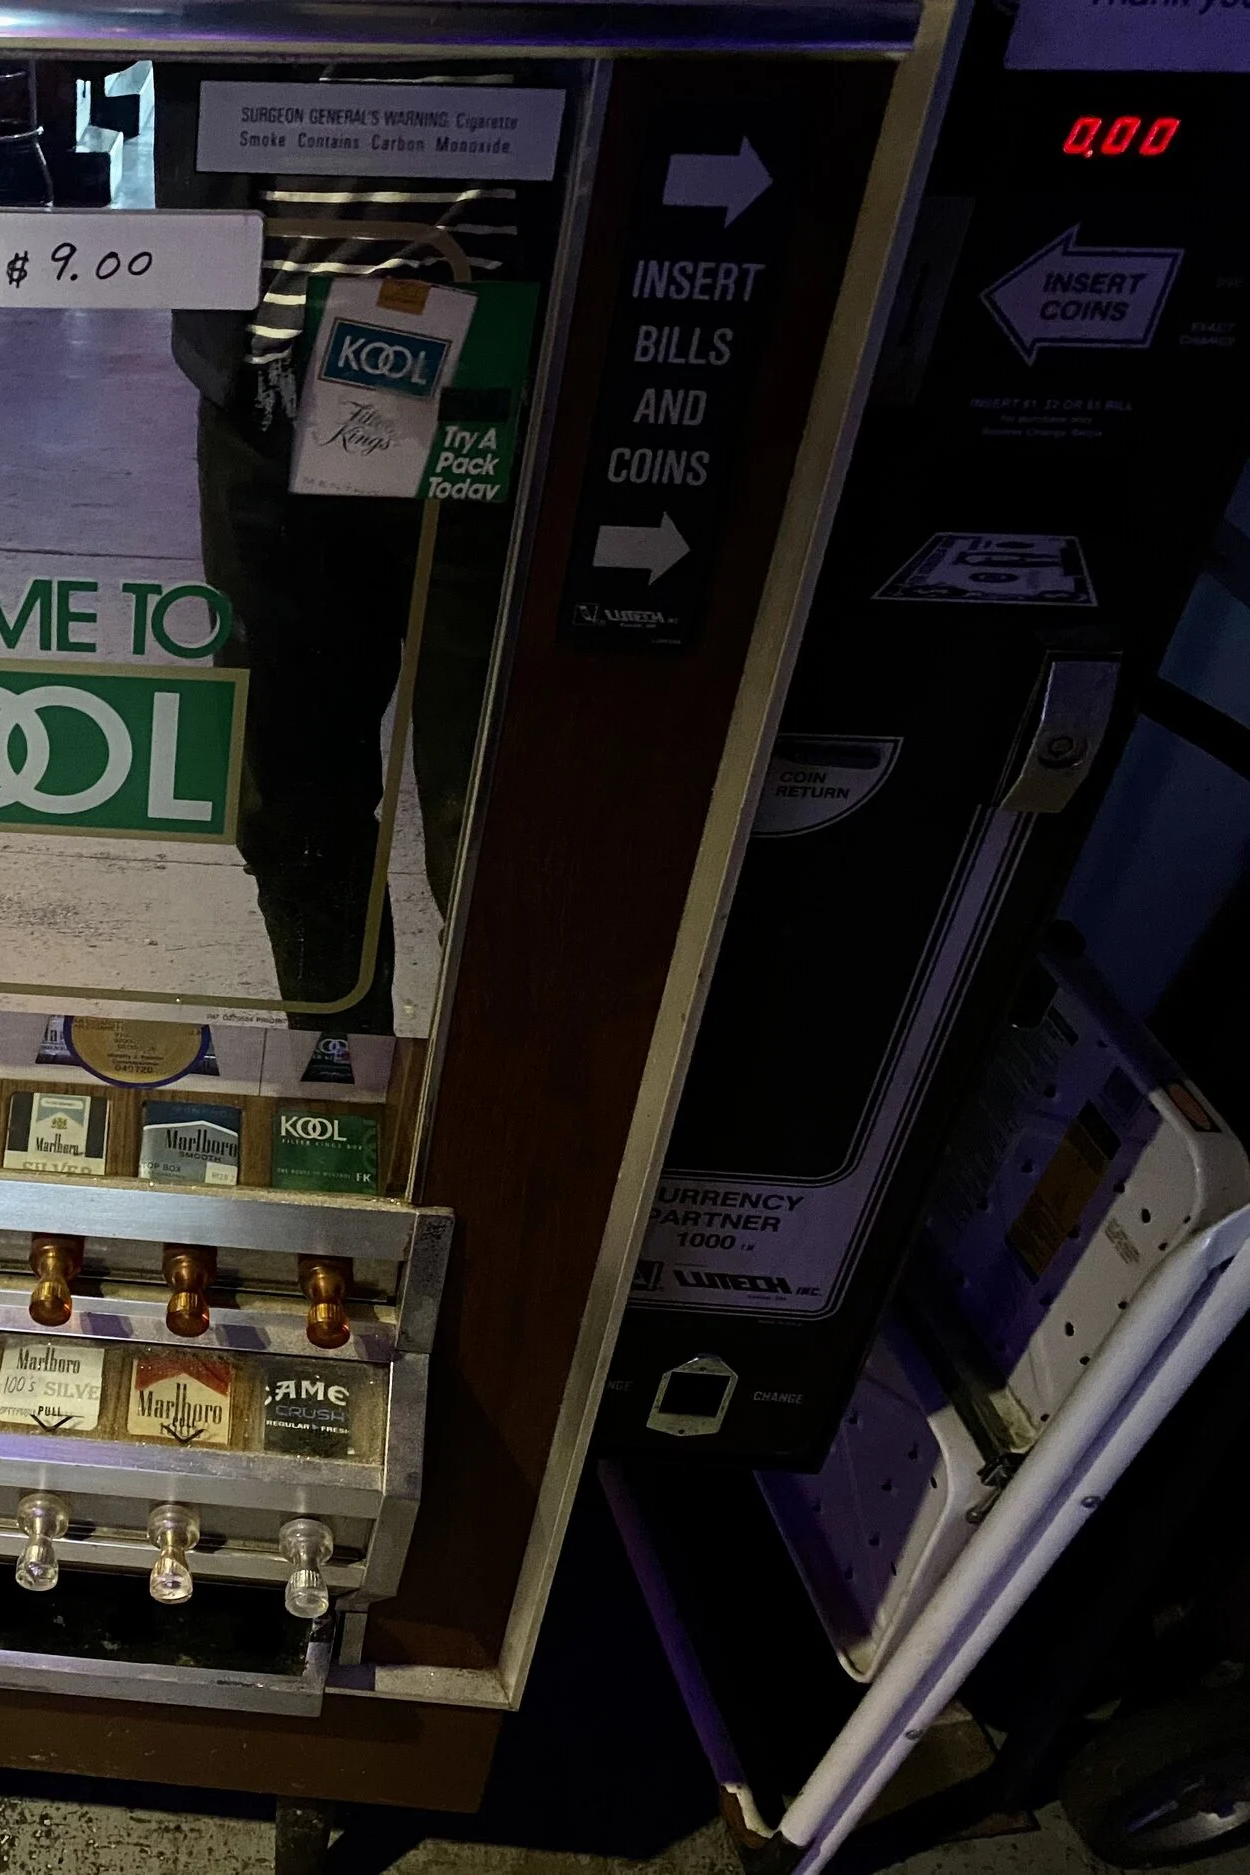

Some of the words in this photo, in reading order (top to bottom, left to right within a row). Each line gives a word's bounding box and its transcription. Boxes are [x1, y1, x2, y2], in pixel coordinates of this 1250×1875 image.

[241, 107, 303, 124] SURGEON
[308, 109, 379, 125] GENERAL'S
[455, 113, 519, 132] Cigarette
[240, 131, 286, 147] Smoke
[298, 132, 360, 149] Contains
[371, 134, 425, 151] Carbon
[435, 137, 511, 154] Monoxide
[1062, 115, 1182, 159] 0.00
[6, 251, 29, 288] $
[50, 242, 153, 281] 9.00
[632, 260, 766, 302] INSERT
[1042, 273, 1148, 294] INSERT
[1040, 300, 1129, 321] COINS
[634, 325, 733, 366] BILLS
[338, 335, 427, 386] KOOL
[633, 388, 707, 426] AND
[320, 424, 392, 456] Kings
[443, 425, 480, 454] Try
[478, 427, 498, 450] A
[435, 451, 500, 476] Pack
[607, 448, 710, 486] COINS
[428, 476, 501, 500] Today
[122, 582, 233, 659] TO
[780, 771, 827, 783] COIN
[775, 786, 849, 799] RETURN
[281, 1116, 347, 1141] KOOL
[36, 1133, 80, 1156] Marlboro
[166, 1128, 238, 1158] Marlboro
[142, 1161, 160, 1170] TOP
[162, 1163, 181, 1172] BOX
[179, 1151, 222, 1162] SMOOTH
[356, 1173, 372, 1182] FK
[655, 1187, 805, 1211] URRENCY
[650, 1208, 781, 1232] PARTNER
[676, 1232, 736, 1249] 1000
[674, 1270, 792, 1294] LUTECH
[797, 1287, 823, 1297] INC.
[16, 1347, 81, 1374] Marlboro
[3, 1375, 37, 1395] 100's
[43, 1381, 100, 1400] SILVE
[265, 1380, 350, 1406] AME
[607, 1381, 634, 1392] NGE
[137, 1383, 222, 1425] Marlboro
[753, 1391, 803, 1405] CHANGE
[38, 1405, 62, 1417] PULL
[275, 1405, 345, 1422] CRUSH
[266, 1420, 310, 1430] REGULAR
